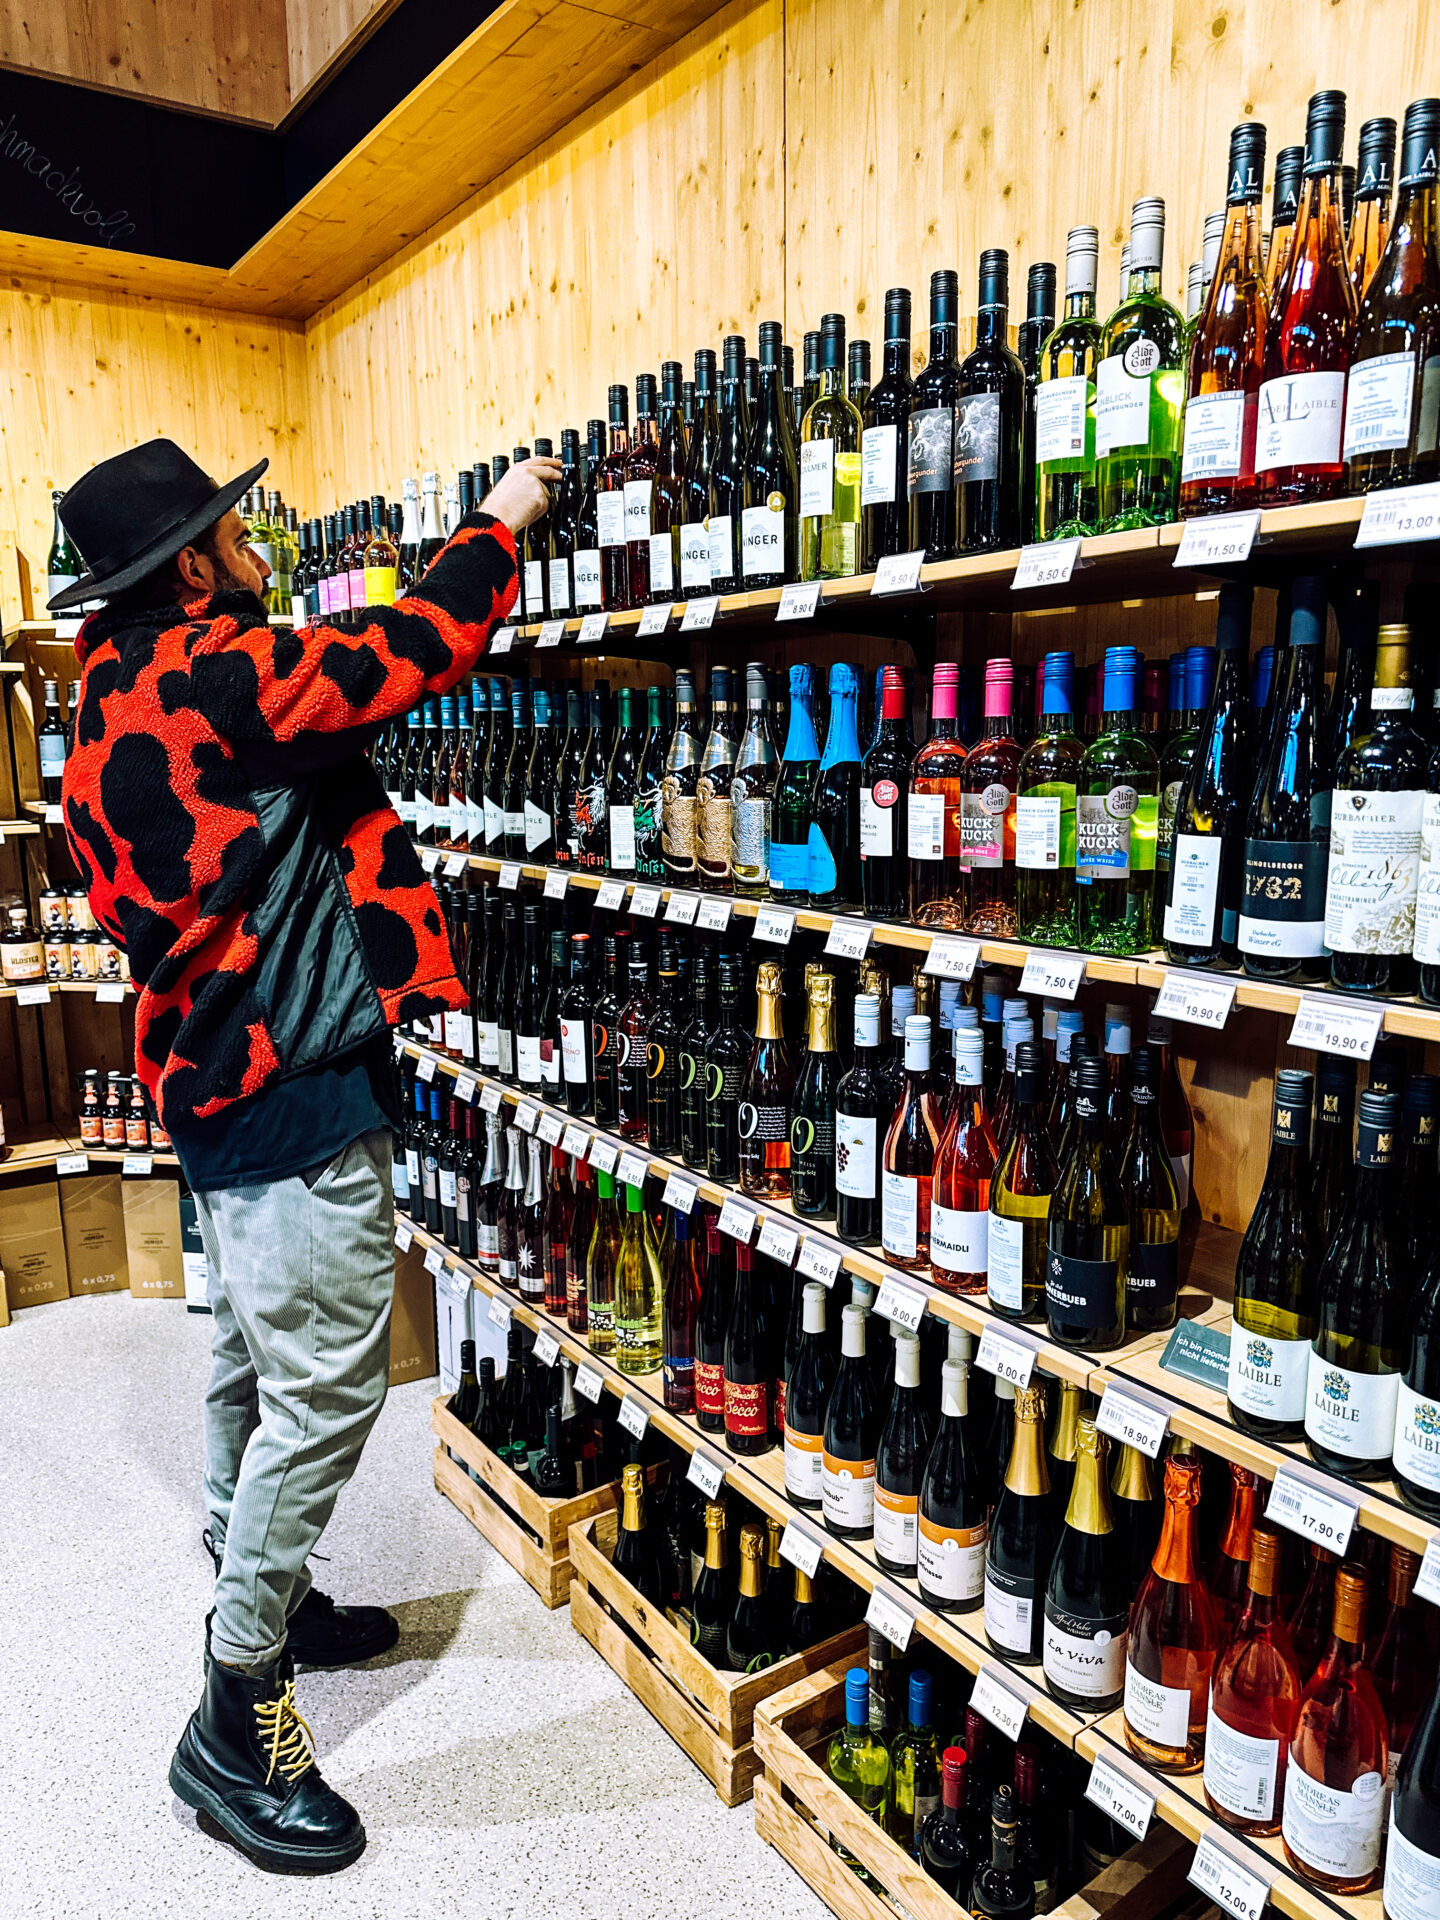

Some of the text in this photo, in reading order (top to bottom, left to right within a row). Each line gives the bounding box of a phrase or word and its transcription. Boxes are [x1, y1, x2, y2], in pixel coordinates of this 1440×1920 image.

[0, 114, 136, 247] hmackvoll
[1230, 168, 1258, 191] AL
[1361, 163, 1390, 185] AL
[1130, 357, 1152, 368] Gott
[1397, 515, 1433, 530] 13,00
[1207, 542, 1246, 557] 11,50 €
[1037, 566, 1070, 582] 8,50 €
[1112, 790, 1134, 801] Alde
[1112, 801, 1132, 810] Gott
[1078, 823, 1120, 836] KUCK
[1158, 818, 1174, 829] CK
[1078, 836, 1120, 849] KUCK
[1157, 831, 1173, 842] CK
[1245, 873, 1302, 901] 1782
[1248, 935, 1282, 947] Winzer eG
[945, 960, 972, 973] 7,50 €
[1045, 974, 1067, 990] 7,50
[1186, 1005, 1223, 1022] 19,90 €
[1325, 1034, 1369, 1052] 19,90 €
[1274, 1129, 1296, 1140] LAIBLE
[82, 1276, 89, 1285] 6
[96, 1274, 116, 1284] 0,75
[813, 1262, 835, 1280] 6,50 €
[19, 1286, 26, 1294] 6
[35, 1281, 54, 1291] 0,75
[142, 1280, 149, 1288] 6
[155, 1280, 174, 1289] 0,75
[892, 1306, 910, 1323] 8,00
[1176, 1336, 1188, 1348] Ich
[1190, 1341, 1202, 1353] bin
[1179, 1348, 1200, 1362] nicht
[997, 1362, 1026, 1385] 8,00 €
[1238, 1361, 1282, 1388] LAIBLE
[725, 1395, 759, 1418] Secco
[1315, 1392, 1360, 1423] LAIBLE
[1123, 1425, 1157, 1450] 18,90 €
[1302, 1514, 1345, 1545] 17,90 €
[882, 1621, 899, 1640] 8,90
[1048, 1638, 1106, 1665] La Viva
[991, 1704, 1019, 1733] 12,30 €
[1296, 1776, 1341, 1807] ANDREAS
[1112, 1799, 1145, 1831] 17,00 €
[1218, 1885, 1257, 1920] 12,00 €
